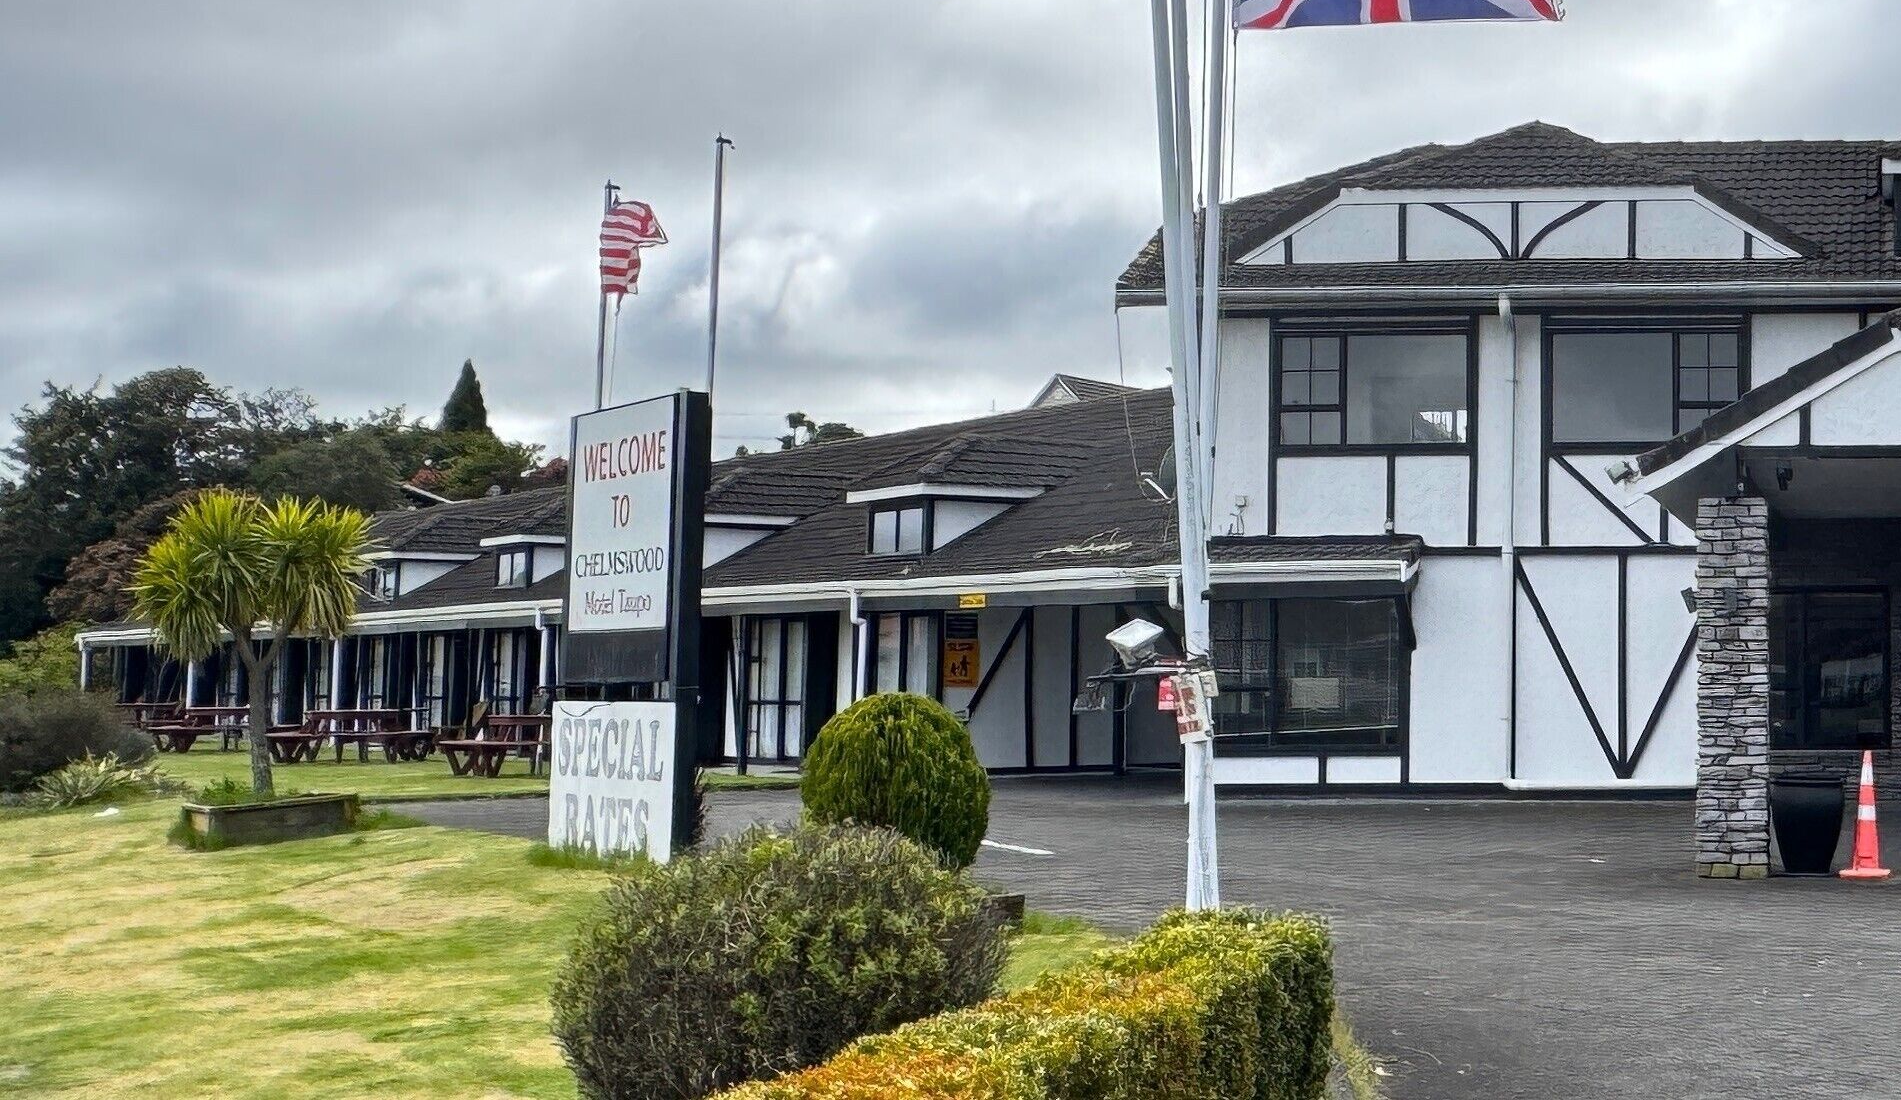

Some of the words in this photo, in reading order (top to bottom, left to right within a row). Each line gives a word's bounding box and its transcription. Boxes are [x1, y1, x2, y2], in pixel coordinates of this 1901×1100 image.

[584, 430, 666, 483] WELCOME
[611, 495, 630, 528] TO
[558, 718, 664, 782] SPECIAL
[565, 793, 649, 853] RATES
